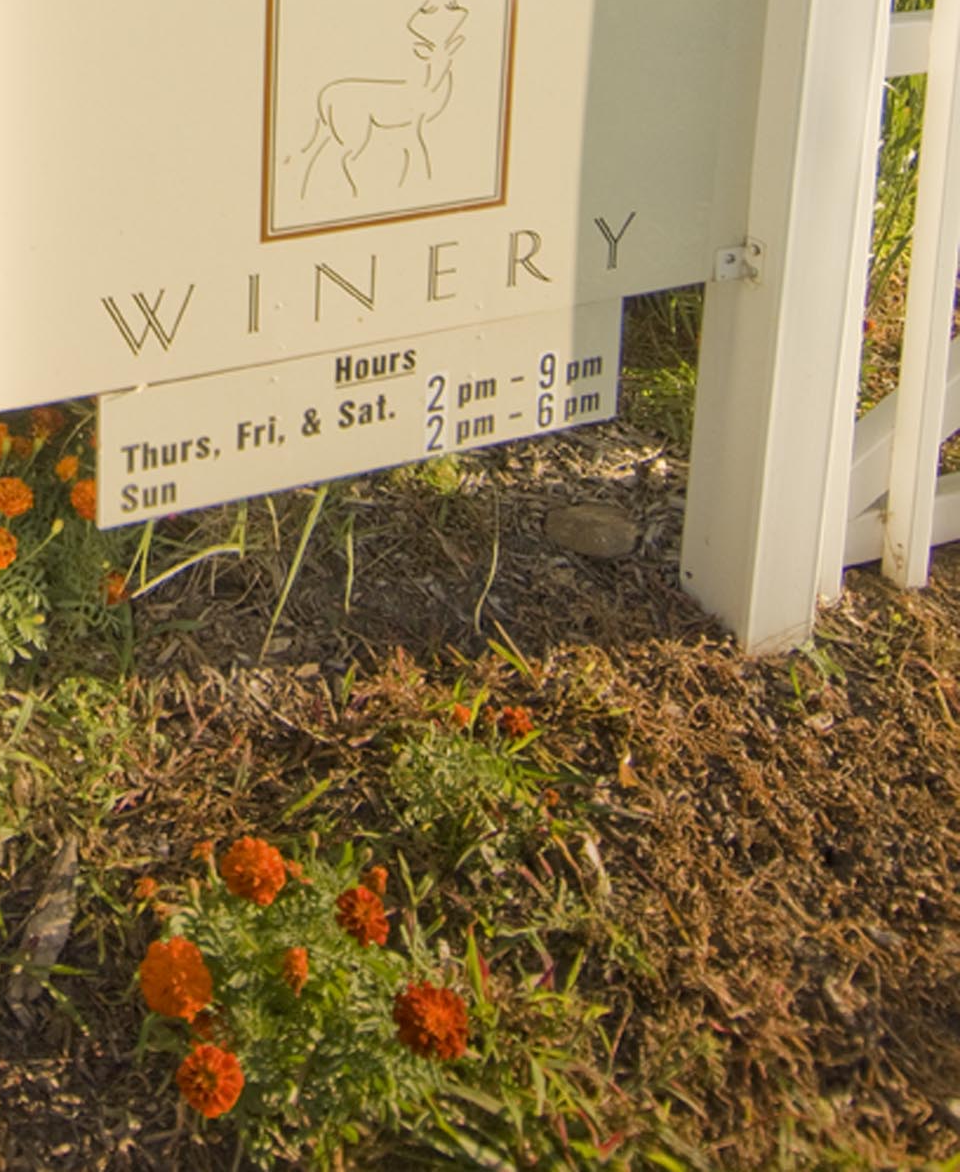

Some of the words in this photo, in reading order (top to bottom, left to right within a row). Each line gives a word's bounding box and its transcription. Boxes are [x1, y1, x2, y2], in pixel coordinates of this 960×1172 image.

[101, 211, 637, 356] WINERY
[121, 436, 221, 474] Thurs,
[237, 416, 285, 451] Fri,
[301, 406, 322, 436] &
[338, 394, 396, 429] Sat.
[427, 375, 446, 412] 2
[458, 378, 496, 408] pm
[539, 354, 555, 388] 9
[566, 353, 602, 384] pm
[336, 349, 417, 384] Hours
[121, 479, 177, 513] Sun
[426, 416, 444, 452] 2
[456, 416, 494, 444] pm
[537, 393, 553, 426] 6
[564, 392, 600, 420] pm
